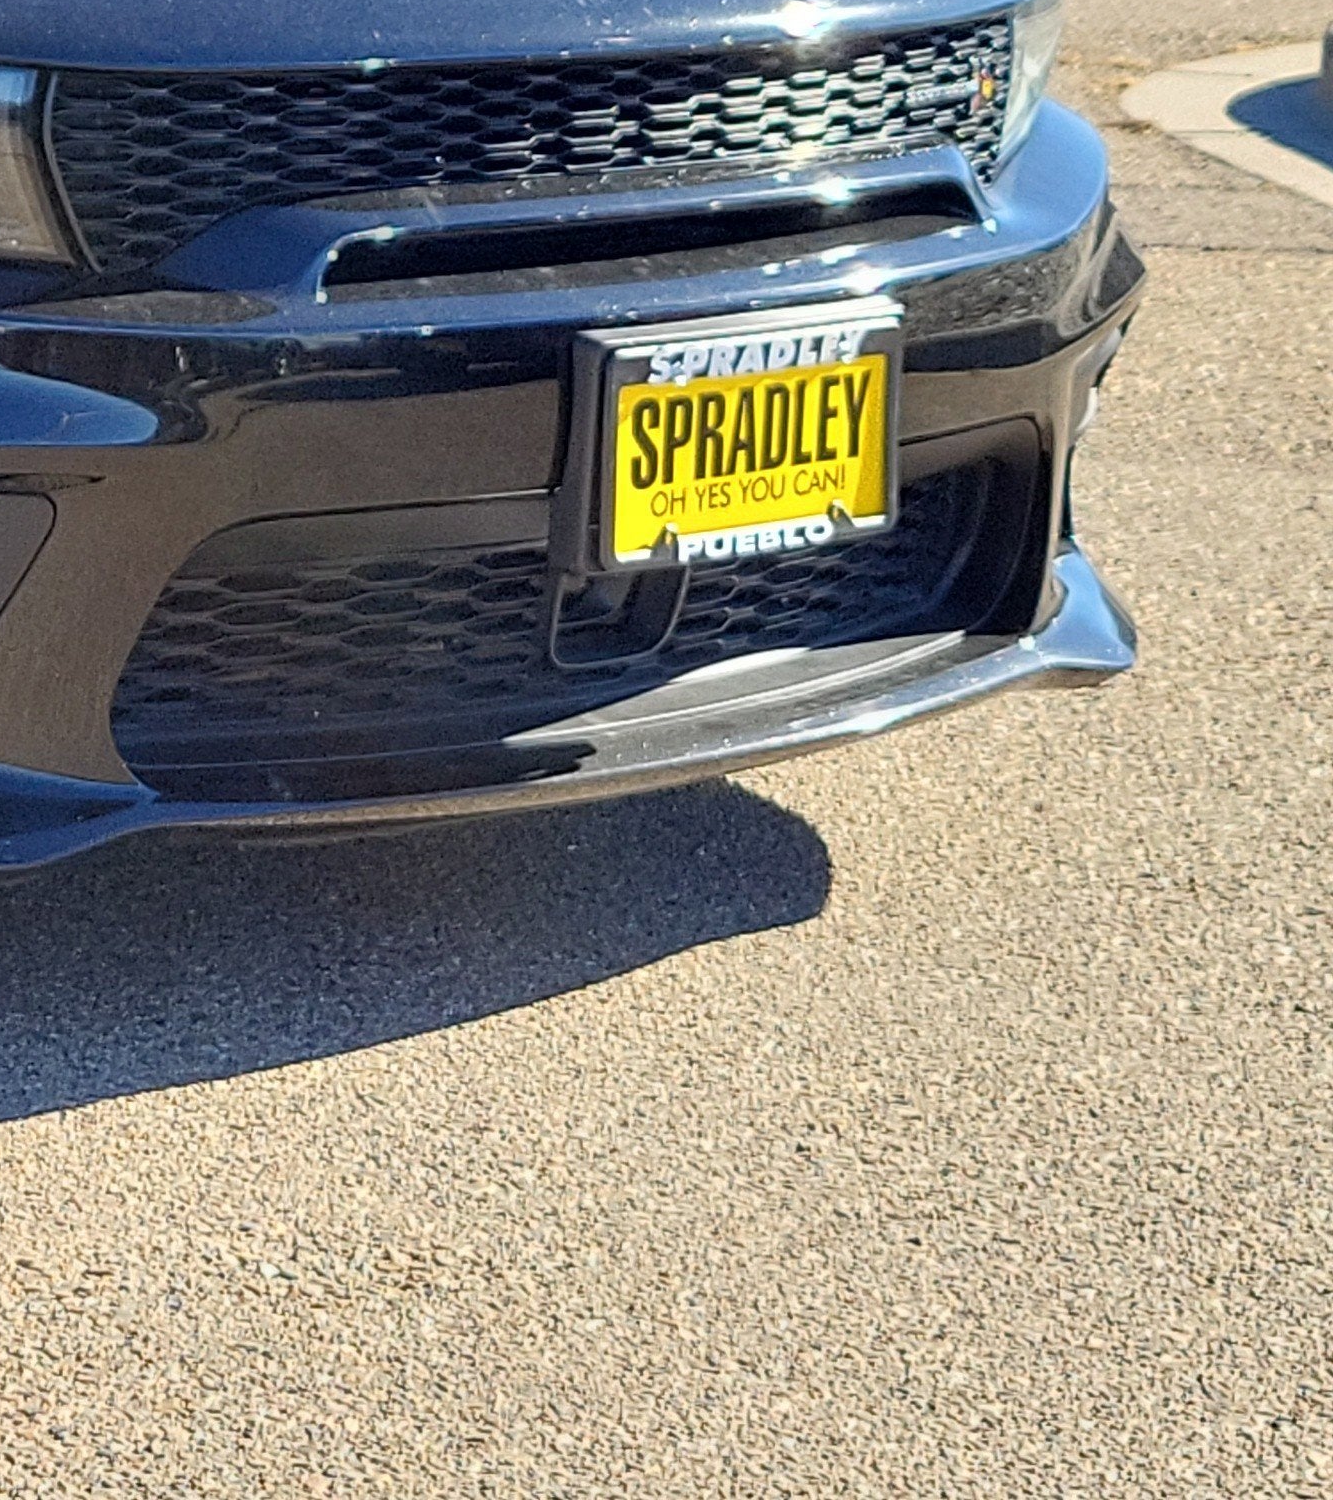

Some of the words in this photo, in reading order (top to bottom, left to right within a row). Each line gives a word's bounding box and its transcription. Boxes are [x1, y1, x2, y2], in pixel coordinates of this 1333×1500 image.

[648, 328, 869, 385] SPRADLEY
[630, 368, 871, 490] SPRADLEY
[650, 489, 687, 518] OH
[696, 481, 731, 510] YES
[738, 474, 786, 504] YOU
[793, 467, 846, 497] CAN!
[677, 519, 833, 562] PUEBLO
